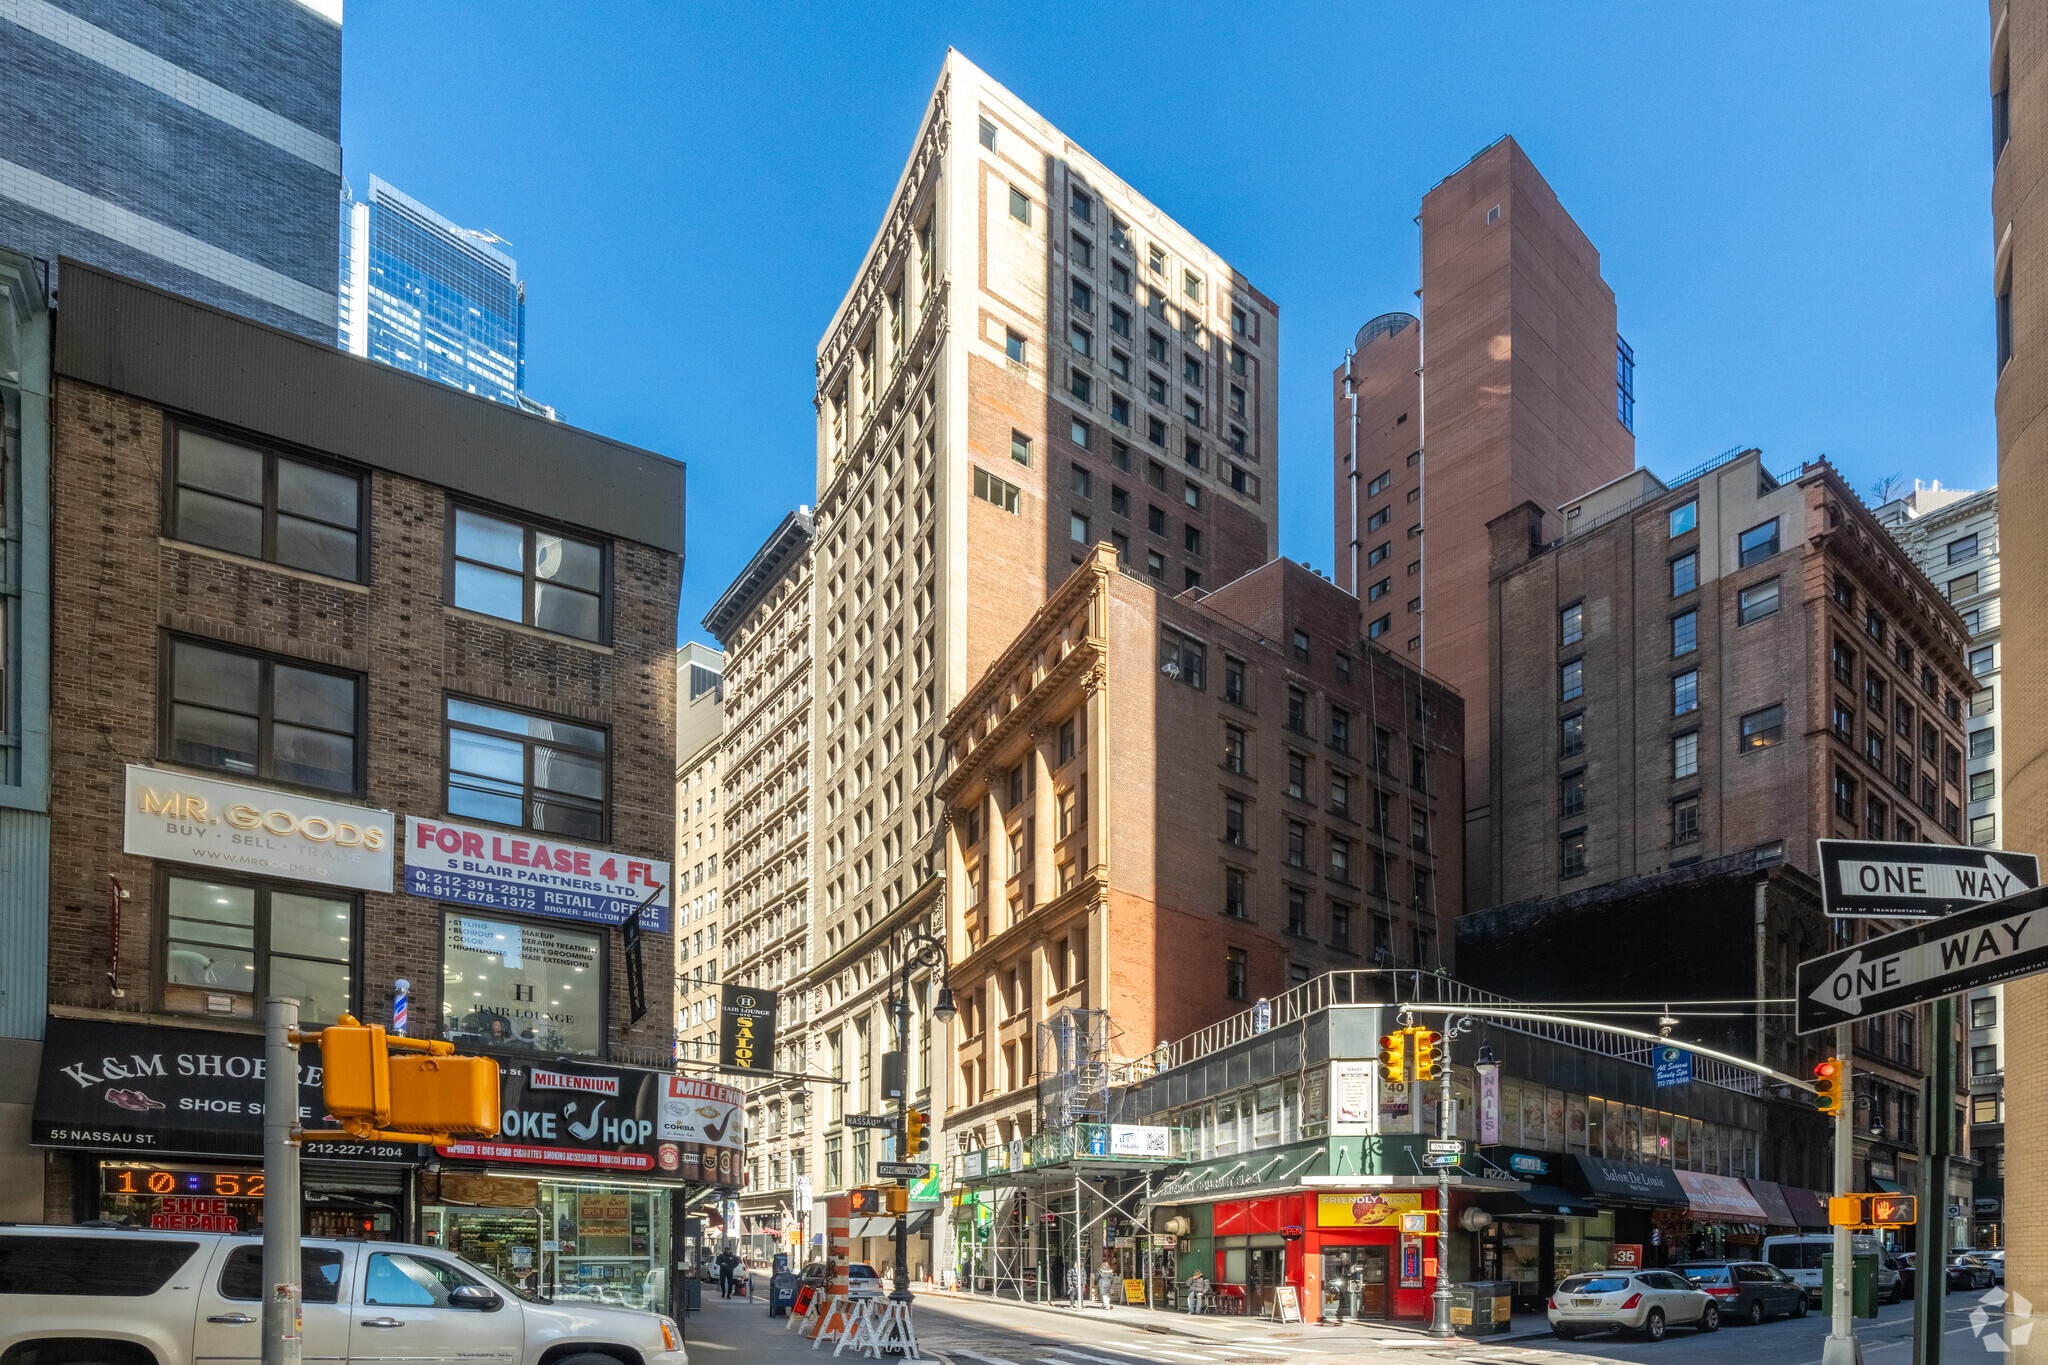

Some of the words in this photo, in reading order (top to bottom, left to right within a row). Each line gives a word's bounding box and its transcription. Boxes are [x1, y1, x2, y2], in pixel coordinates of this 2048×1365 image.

[138, 787, 218, 824] MR.
[223, 802, 385, 851] GOODS
[166, 823, 207, 838] BUY
[232, 834, 275, 850] SELL
[298, 844, 361, 863] TRADE
[416, 823, 485, 859] FOR
[492, 837, 591, 876] LEASE
[600, 858, 618, 880] 4
[627, 861, 660, 888] FL
[433, 874, 535, 898] 212-391-2815
[447, 859, 459, 869] S
[463, 861, 513, 878] BLAIR
[517, 870, 602, 892] PARTNERS
[606, 885, 639, 898] LTD.
[1859, 865, 1926, 893] ONE
[1955, 869, 2011, 899] WAY
[433, 885, 536, 910] 917-678-1372
[545, 892, 595, 909] RETAIL
[610, 901, 659, 920] OFFCE
[545, 906, 582, 917] BROKER:
[583, 911, 620, 921] SHELTON
[453, 919, 488, 929] STYLING
[453, 928, 494, 938] BLOWOUT
[453, 936, 483, 945] COLOR
[522, 930, 555, 939] MAKEUP
[522, 938, 554, 947] KERATIN
[522, 946, 546, 955] MEN'S
[548, 949, 593, 961] GROOMING
[1832, 957, 1900, 1000] ONE
[1940, 916, 2032, 971] WAY
[543, 957, 589, 968] EXTENSIONS
[1943, 984, 1962, 992] DEPT
[1988, 961, 2048, 980] TRANSPORTAT
[513, 983, 536, 1002] H
[474, 1004, 510, 1016] HAIR
[516, 1010, 574, 1024] LOUNGE
[741, 1008, 770, 1016] LOUNGE
[735, 1017, 754, 1068] SALON
[60, 1054, 168, 1088] K&M
[177, 1054, 266, 1079] SHOE
[1657, 1064, 1666, 1072] All
[1668, 1062, 1688, 1070] Seasons
[1676, 1069, 1687, 1077] Spa
[535, 1073, 615, 1092] MILLENNIUM
[1384, 1083, 1404, 1092] $40
[676, 1080, 743, 1106] MILLENN
[179, 1098, 241, 1113] SHOE
[1485, 1076, 1494, 1130] NAILS
[502, 1110, 557, 1139] OKE
[664, 1123, 695, 1131] COHIBA
[846, 1117, 876, 1126] NASSAU
[50, 1129, 67, 1138] 55
[71, 1131, 132, 1143] NASSAU
[135, 1134, 156, 1144] ST.
[307, 1143, 402, 1157] 212-227-1204
[496, 1147, 511, 1156] CIGAR
[513, 1148, 542, 1159] CIGARETTES
[544, 1151, 565, 1160] SMOKING
[599, 1154, 620, 1164] TOBACCO
[622, 1157, 635, 1166] LOTTO
[1484, 1167, 1511, 1180] PIZZA
[1603, 1168, 1629, 1182] Salon
[1628, 1172, 1641, 1184] De
[1641, 1173, 1664, 1187] Louie
[161, 1197, 228, 1214] SHOE
[1322, 1195, 1378, 1204] FRIENDLY
[1382, 1195, 1417, 1204] PIZZA
[151, 1214, 238, 1232] REPAIR
[1614, 1251, 1634, 1262] $35
